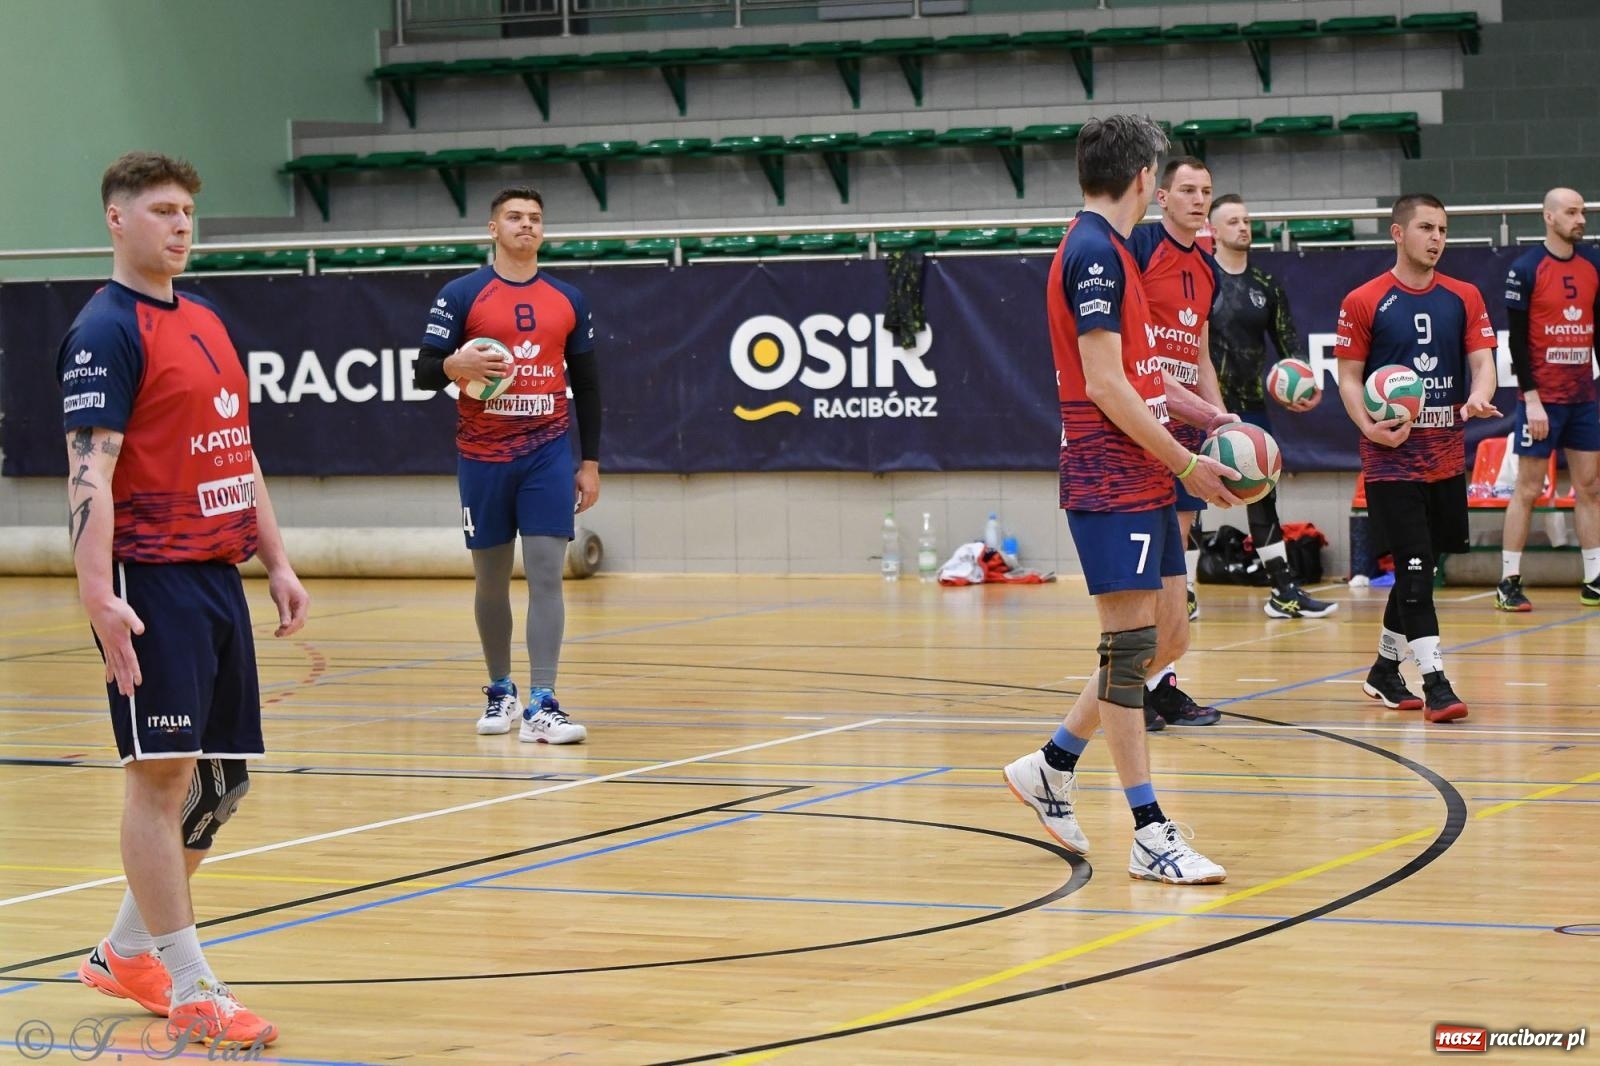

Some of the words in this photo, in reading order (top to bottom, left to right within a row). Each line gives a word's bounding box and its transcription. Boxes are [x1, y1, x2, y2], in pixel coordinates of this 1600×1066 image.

[1078, 277, 1115, 290] KATOLIK
[1182, 270, 1195, 301] 11
[1563, 276, 1578, 299] 5
[514, 304, 536, 332] 8
[1414, 313, 1432, 345] 9
[1154, 325, 1200, 348] KATOLI
[191, 334, 220, 374] 1
[63, 366, 107, 382] KATOLIK
[514, 364, 555, 377] TOLIK
[813, 391, 938, 418] RACIBÓRZ
[190, 425, 251, 455] KATOLI
[1521, 424, 1533, 447] 5
[463, 506, 475, 537] 4
[1130, 533, 1151, 574] 7
[148, 715, 192, 727] ITALIA
